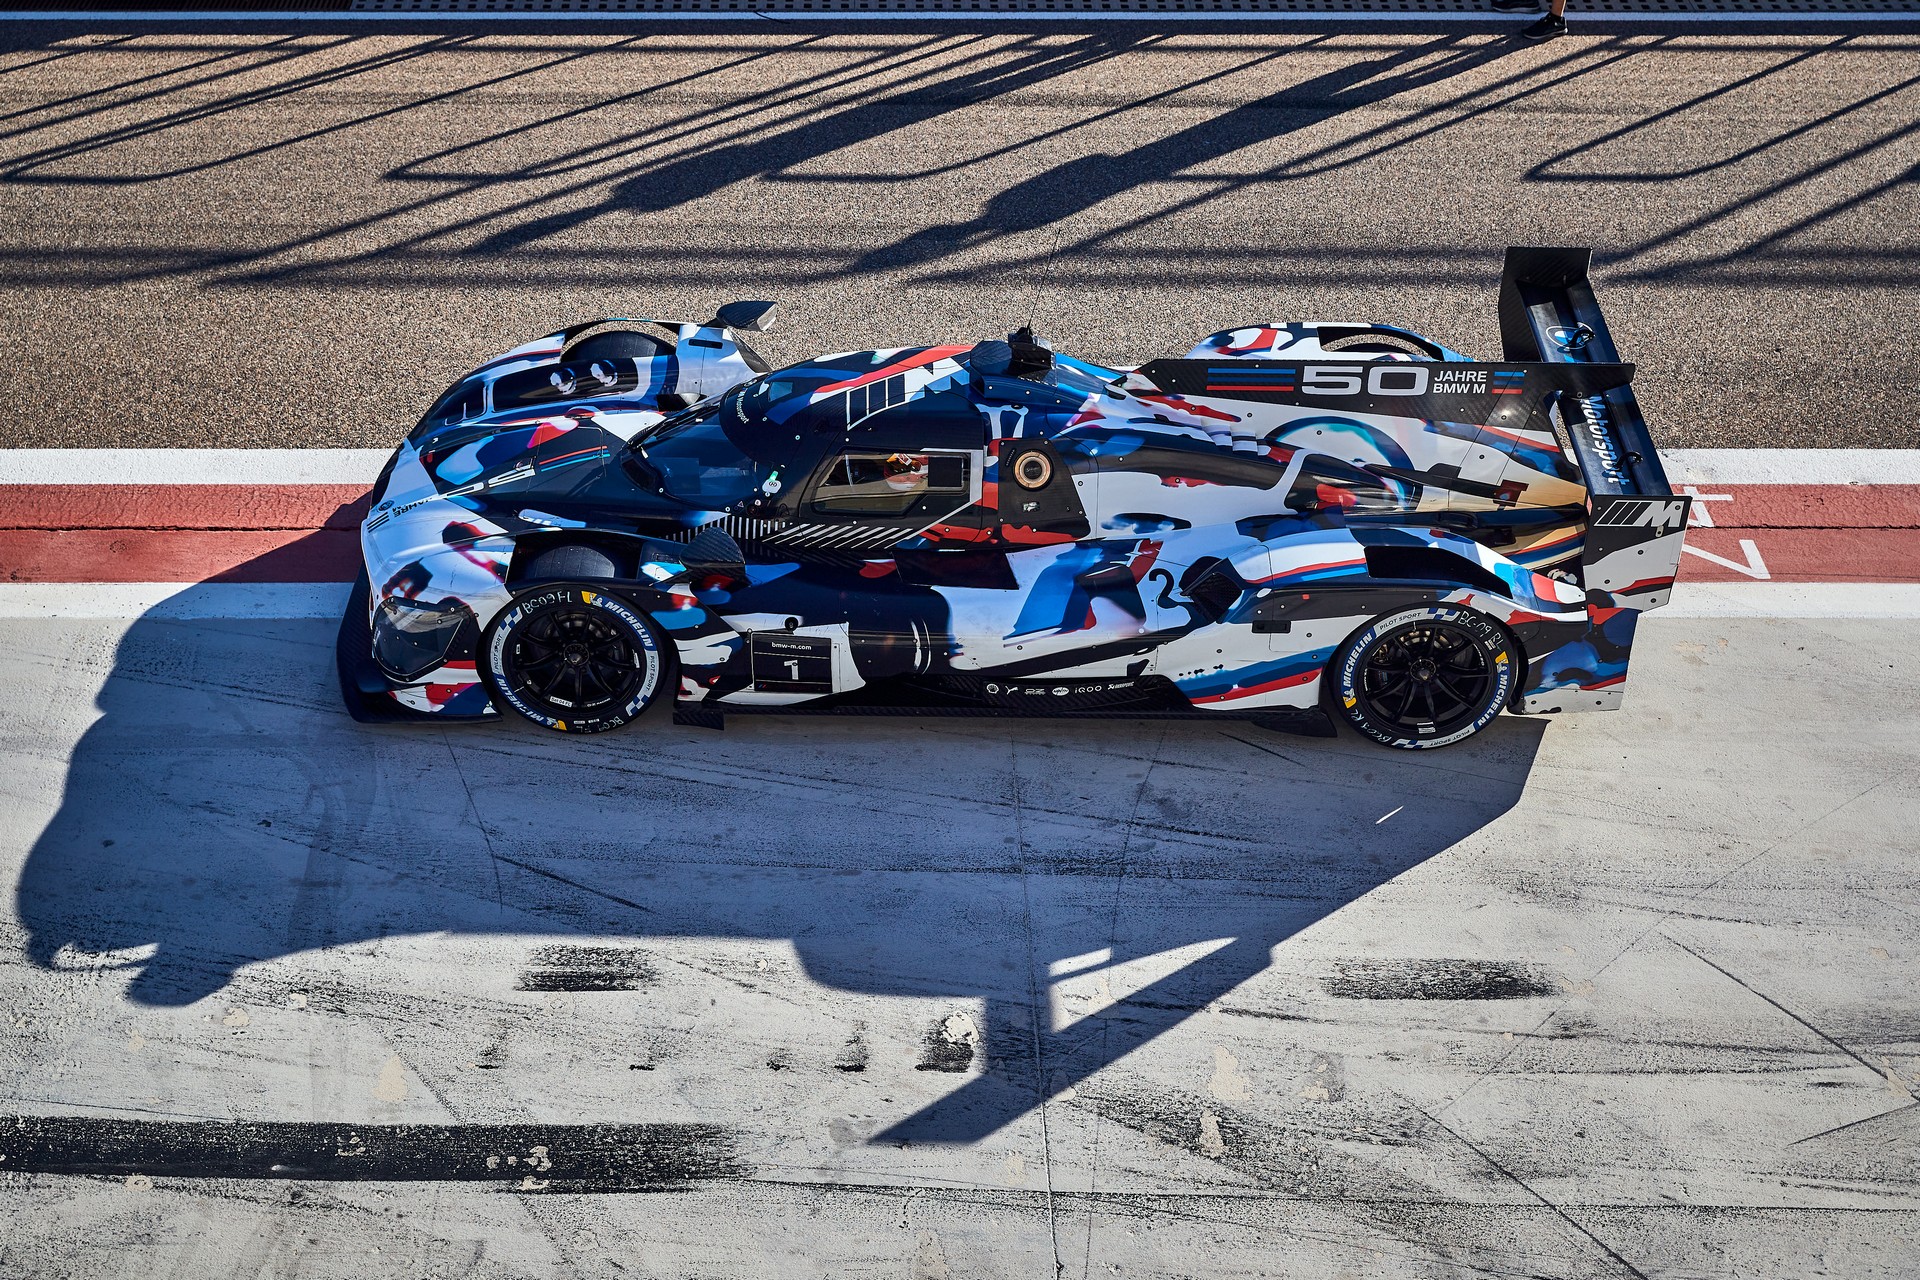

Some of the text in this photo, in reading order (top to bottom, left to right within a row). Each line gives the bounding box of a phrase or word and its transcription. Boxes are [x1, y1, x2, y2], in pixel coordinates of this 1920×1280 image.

[1301, 365, 1430, 396] 50
[1433, 370, 1488, 382] JAHRE
[1432, 383, 1487, 394] BMW M
[1580, 395, 1630, 485] Motorsport
[1631, 500, 1685, 528] M
[604, 599, 654, 647] MICHELIN
[1379, 612, 1422, 630] PILOT SPORT
[771, 641, 812, 651] bmw-m.com
[783, 659, 799, 680] 1
[1342, 632, 1373, 688] MICHELIN
[645, 672, 655, 691] SPORT
[496, 677, 545, 722] MICHELIN
[1476, 673, 1509, 727] MICHELIN
[1429, 730, 1470, 746] PILOT SPORT
